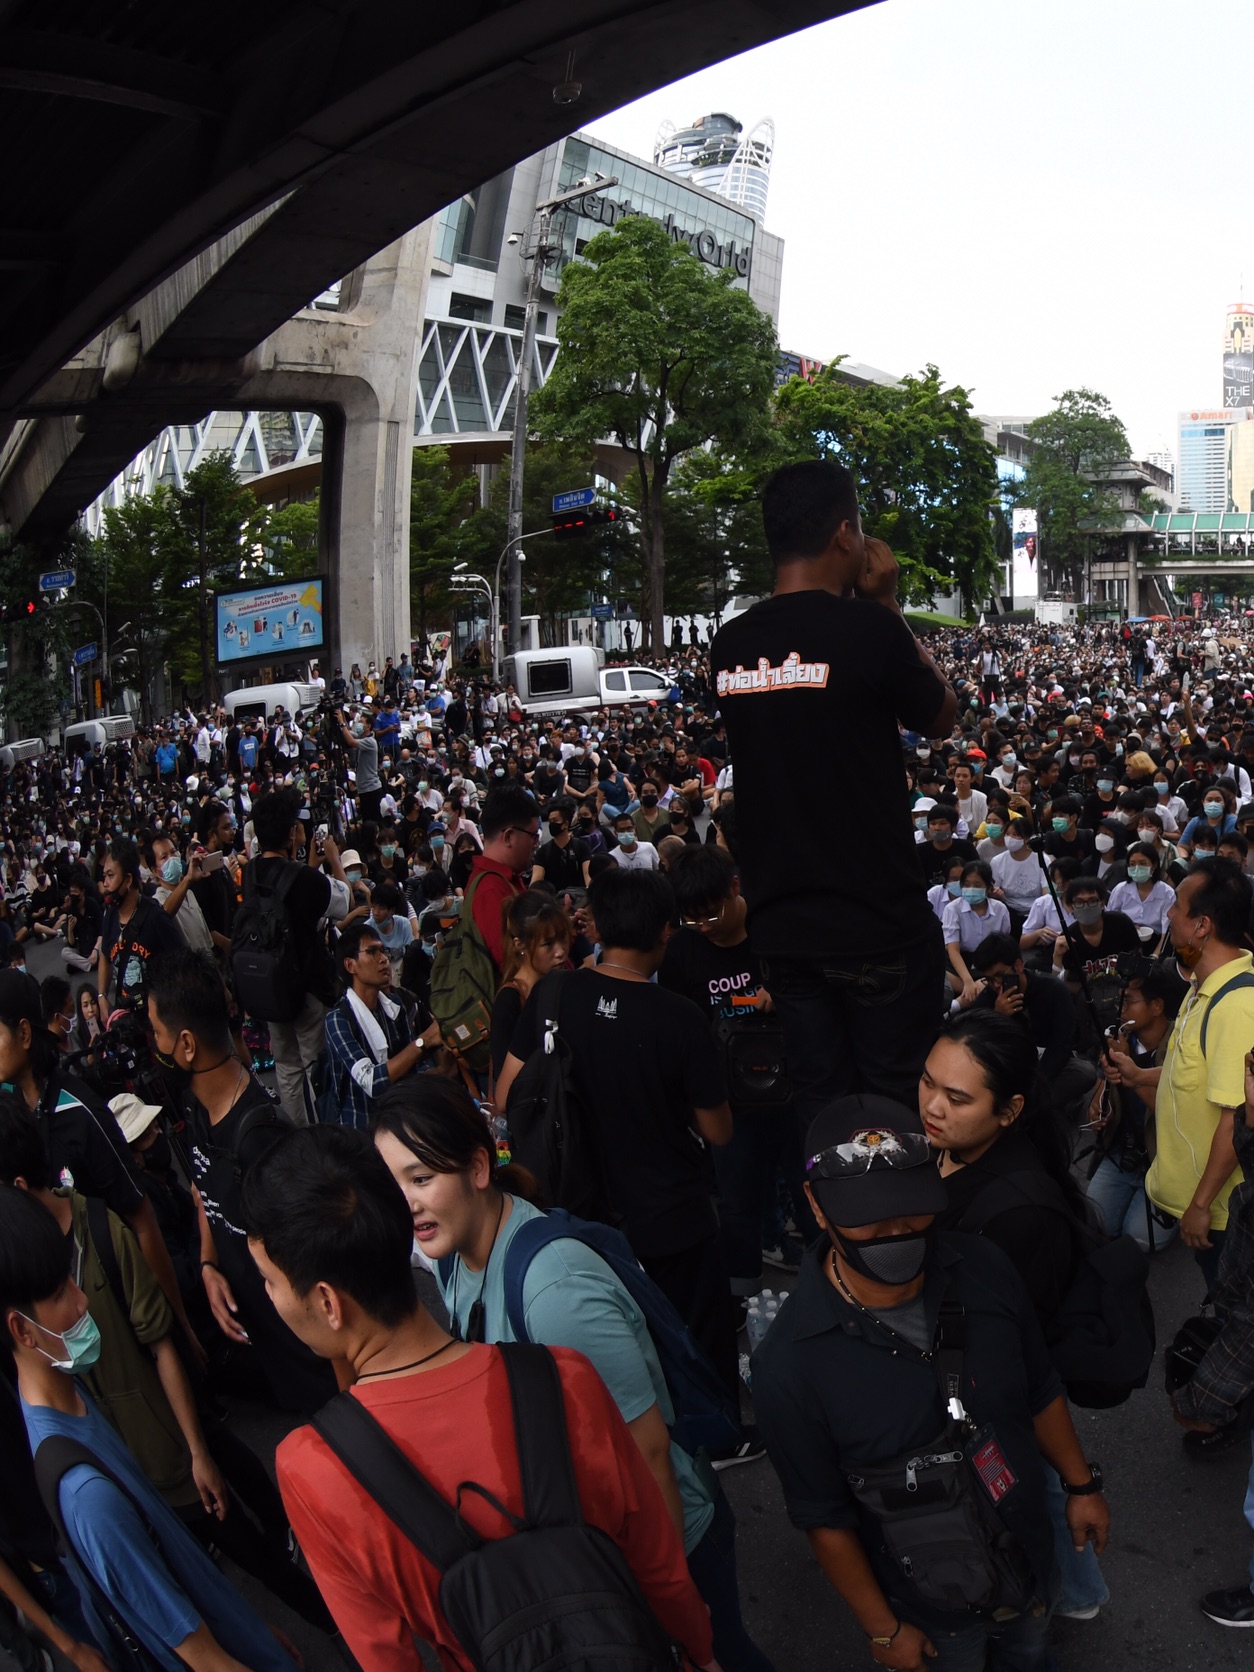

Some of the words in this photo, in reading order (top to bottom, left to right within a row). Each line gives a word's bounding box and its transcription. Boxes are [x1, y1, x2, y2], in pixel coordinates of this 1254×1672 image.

[1225, 385, 1251, 397] THE
[1225, 396, 1240, 407] X7
[1200, 411, 1233, 420] Amari
[271, 593, 298, 605] COVID-19
[708, 972, 751, 993] COUP
